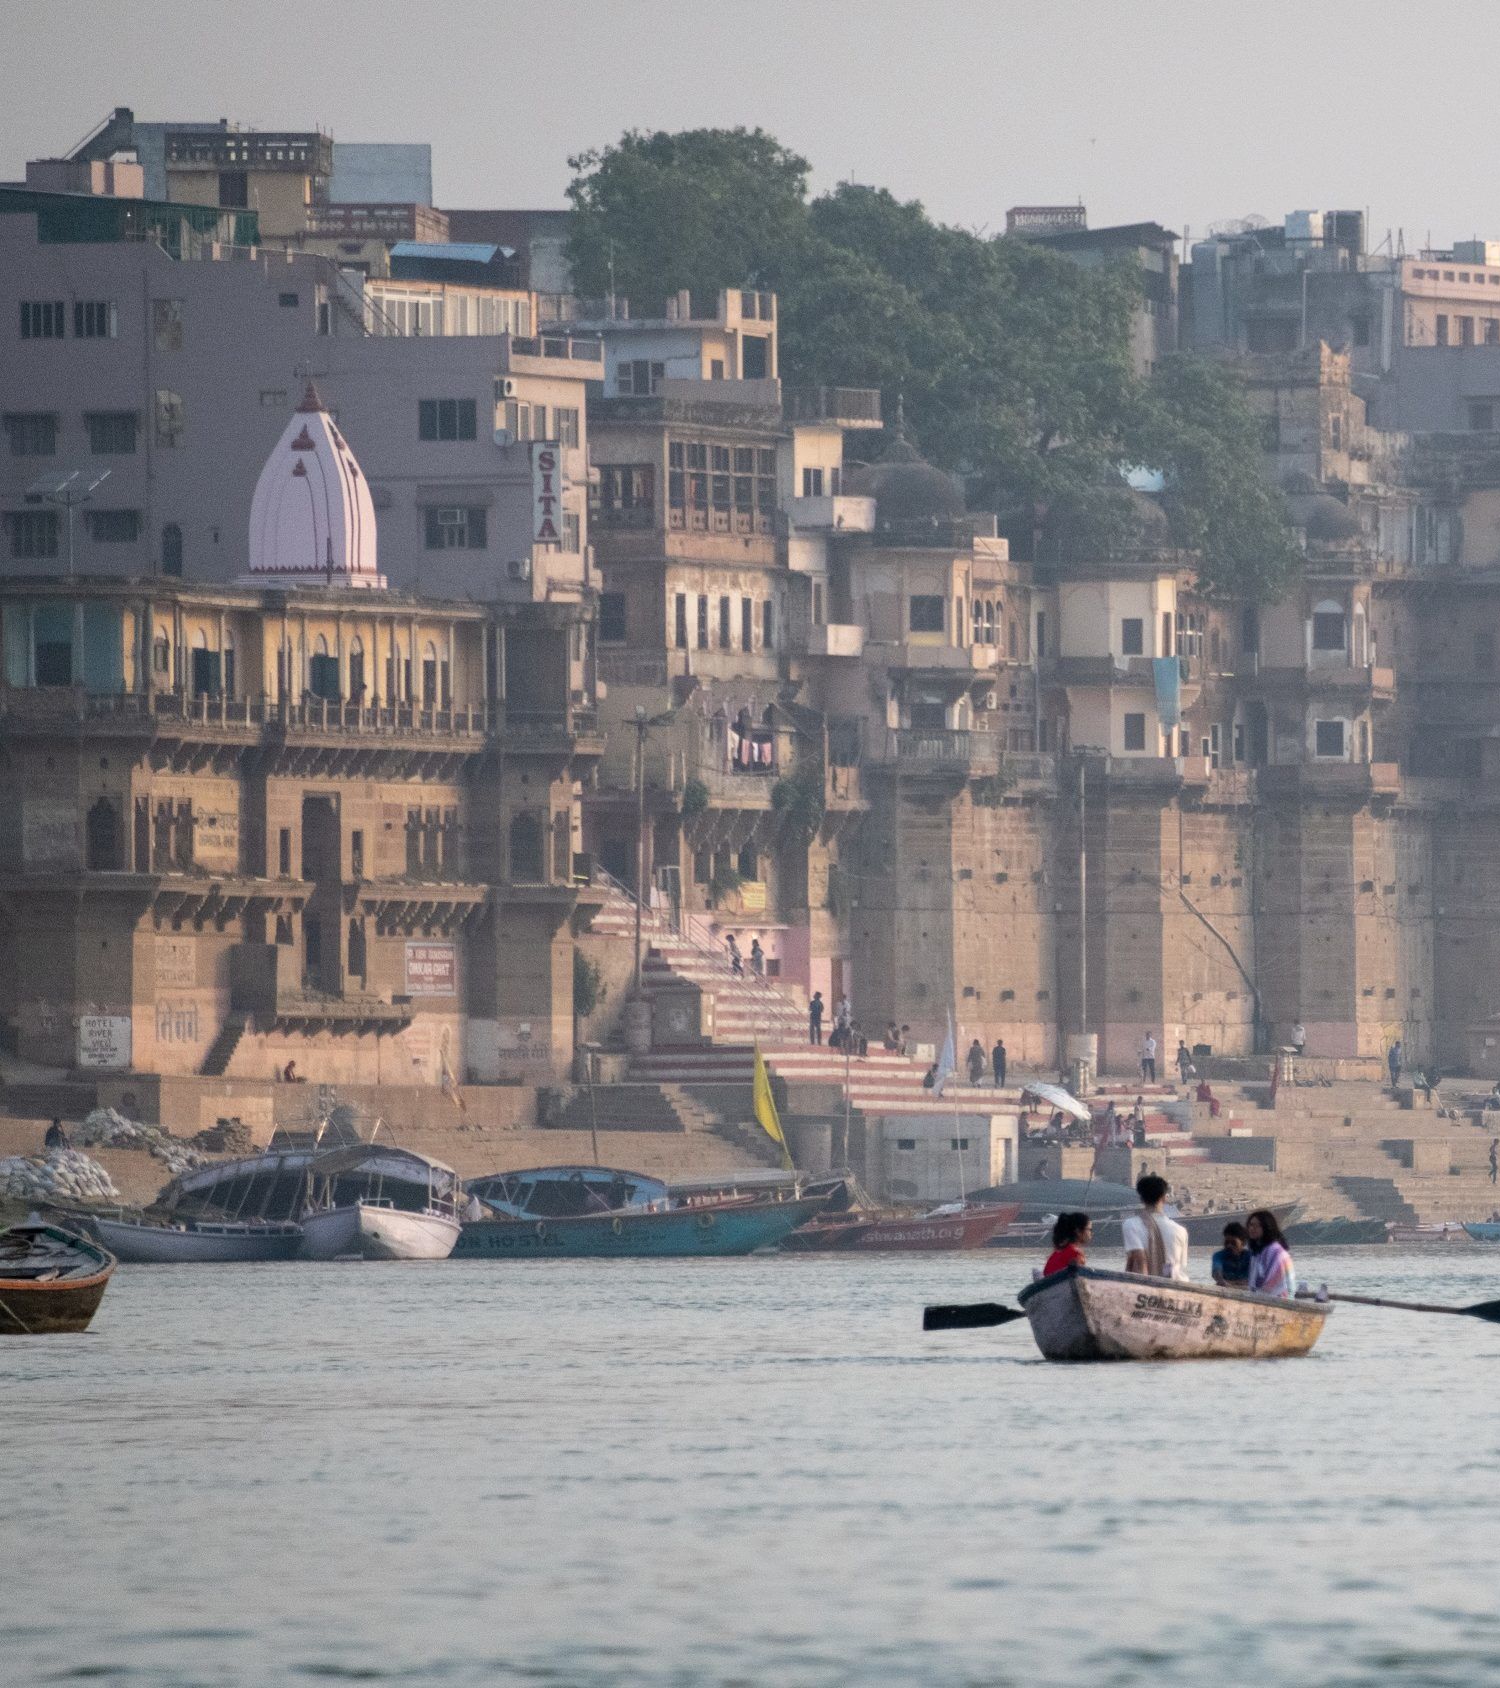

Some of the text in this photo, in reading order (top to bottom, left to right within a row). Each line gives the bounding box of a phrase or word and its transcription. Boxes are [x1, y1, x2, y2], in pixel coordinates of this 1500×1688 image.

[538, 451, 558, 538] SITA
[85, 1019, 114, 1028] HOTEL
[89, 1029, 112, 1039] RIVER
